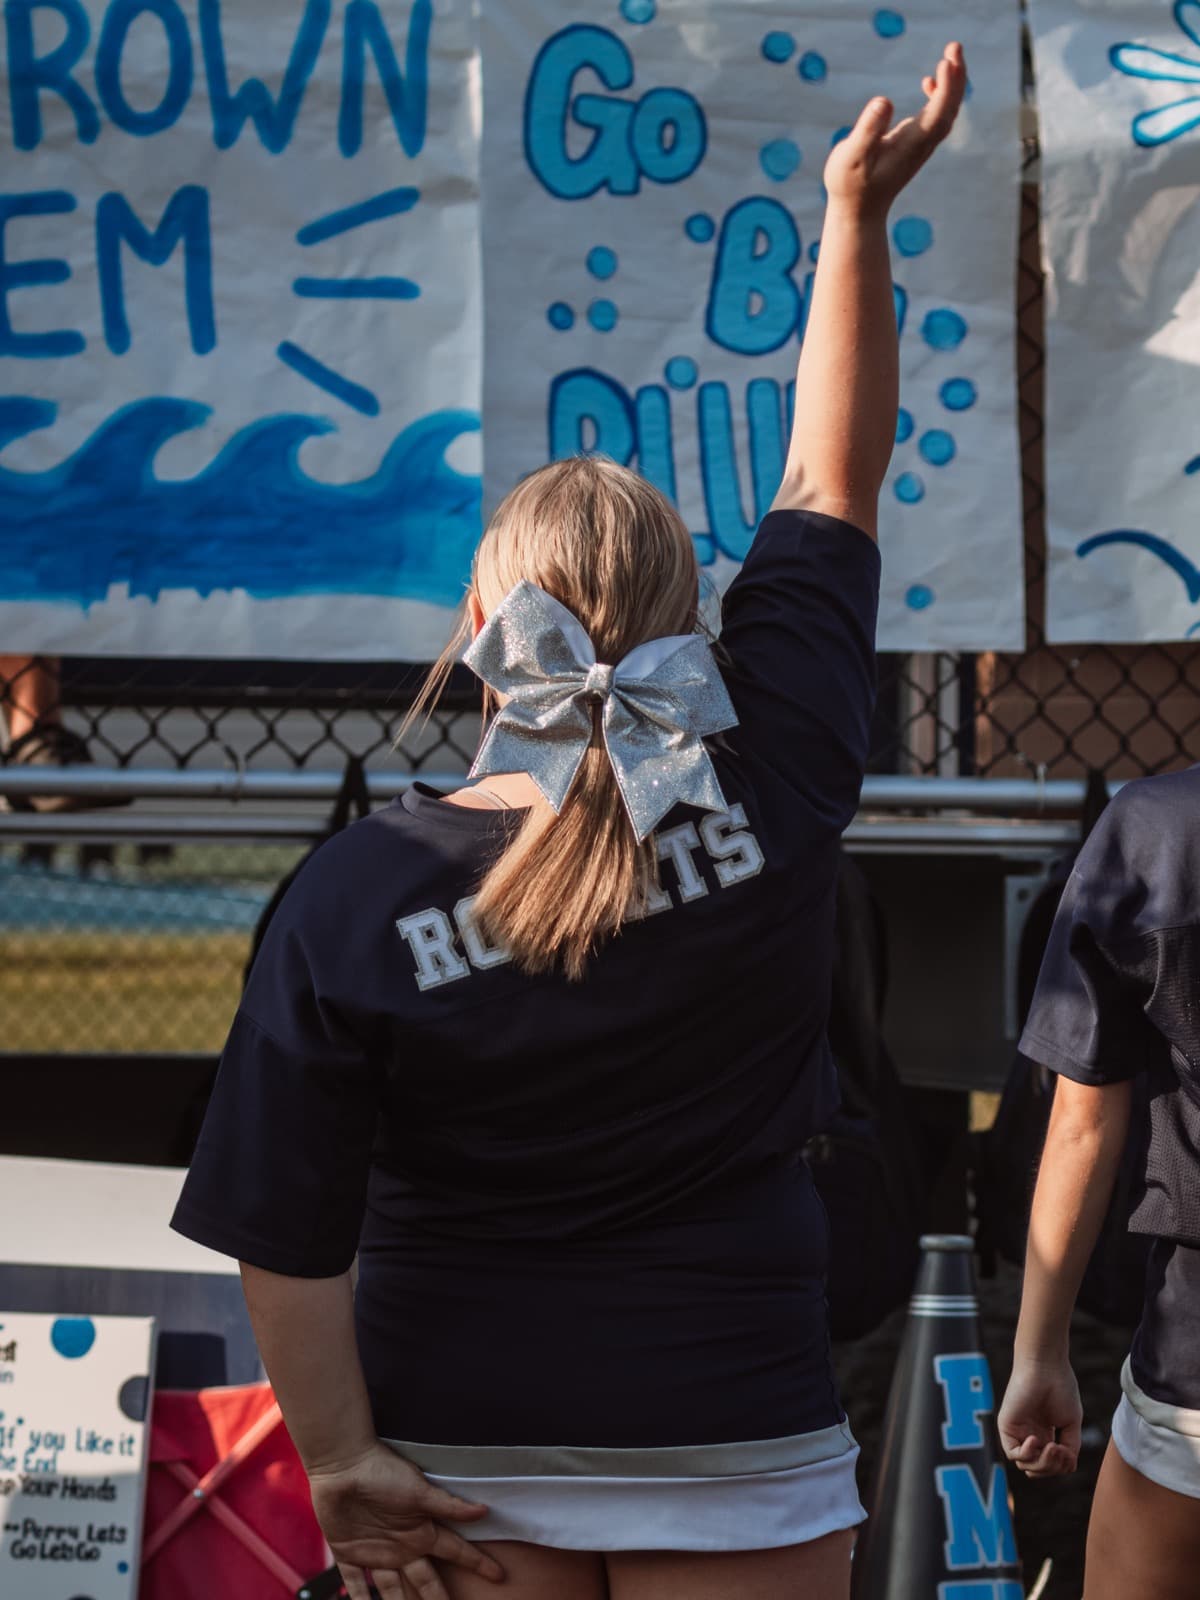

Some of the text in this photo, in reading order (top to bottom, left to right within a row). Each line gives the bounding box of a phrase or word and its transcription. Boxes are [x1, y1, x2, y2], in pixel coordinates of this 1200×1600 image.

[4, 0, 433, 158] ROWN
[523, 23, 708, 200] Go
[0, 185, 216, 358] EM
[18, 1472, 59, 1497] Your
[61, 1475, 117, 1501] Hands
[29, 1430, 65, 1452] you
[76, 1427, 114, 1454] like
[119, 1432, 135, 1456] it
